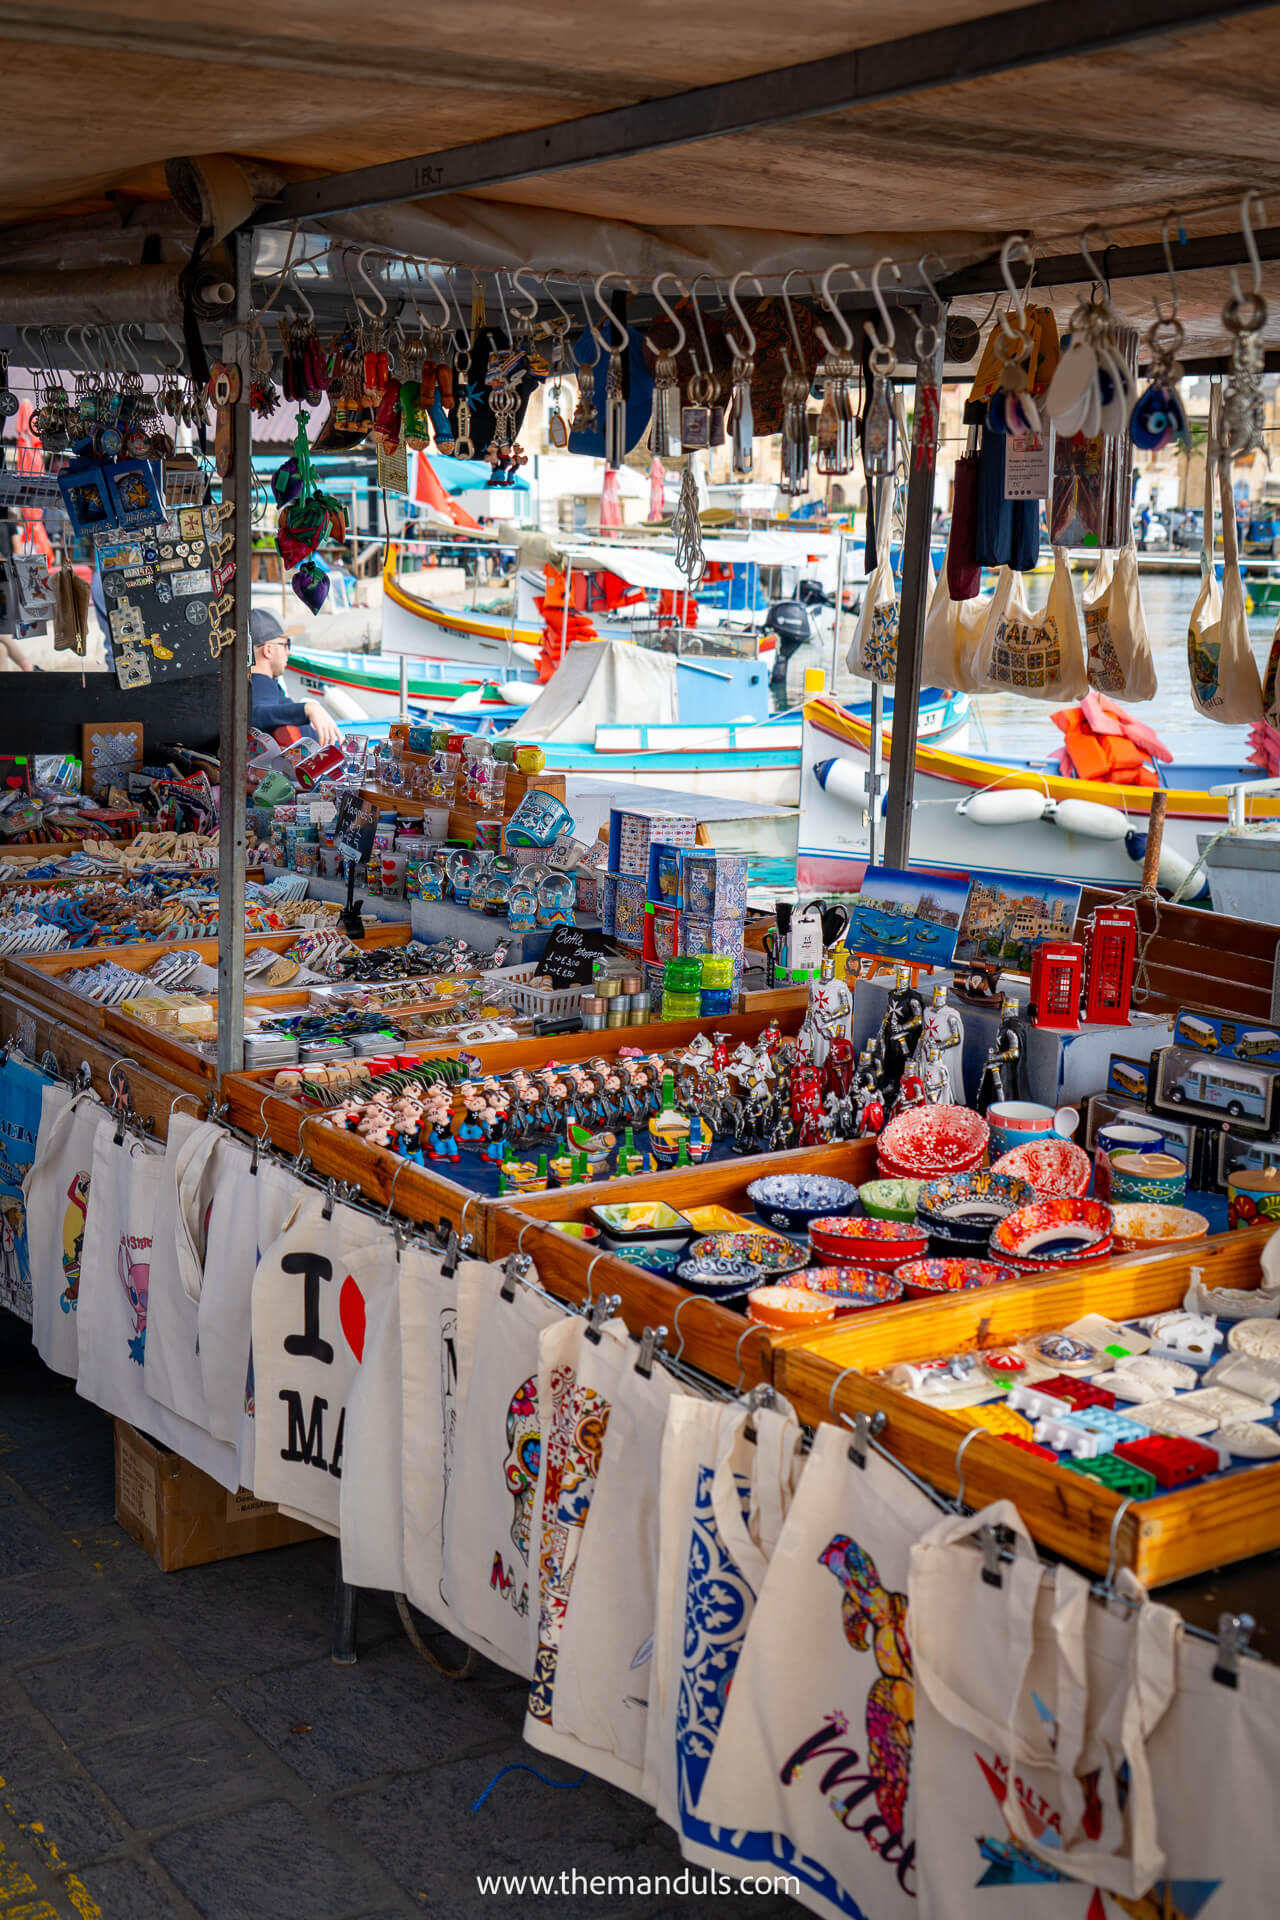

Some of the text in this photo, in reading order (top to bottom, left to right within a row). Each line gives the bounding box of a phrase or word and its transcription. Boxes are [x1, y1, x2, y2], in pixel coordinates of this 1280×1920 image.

[555, 927, 584, 946] Bottle
[128, 1236, 153, 1250] STITC
[281, 1252, 334, 1365] I
